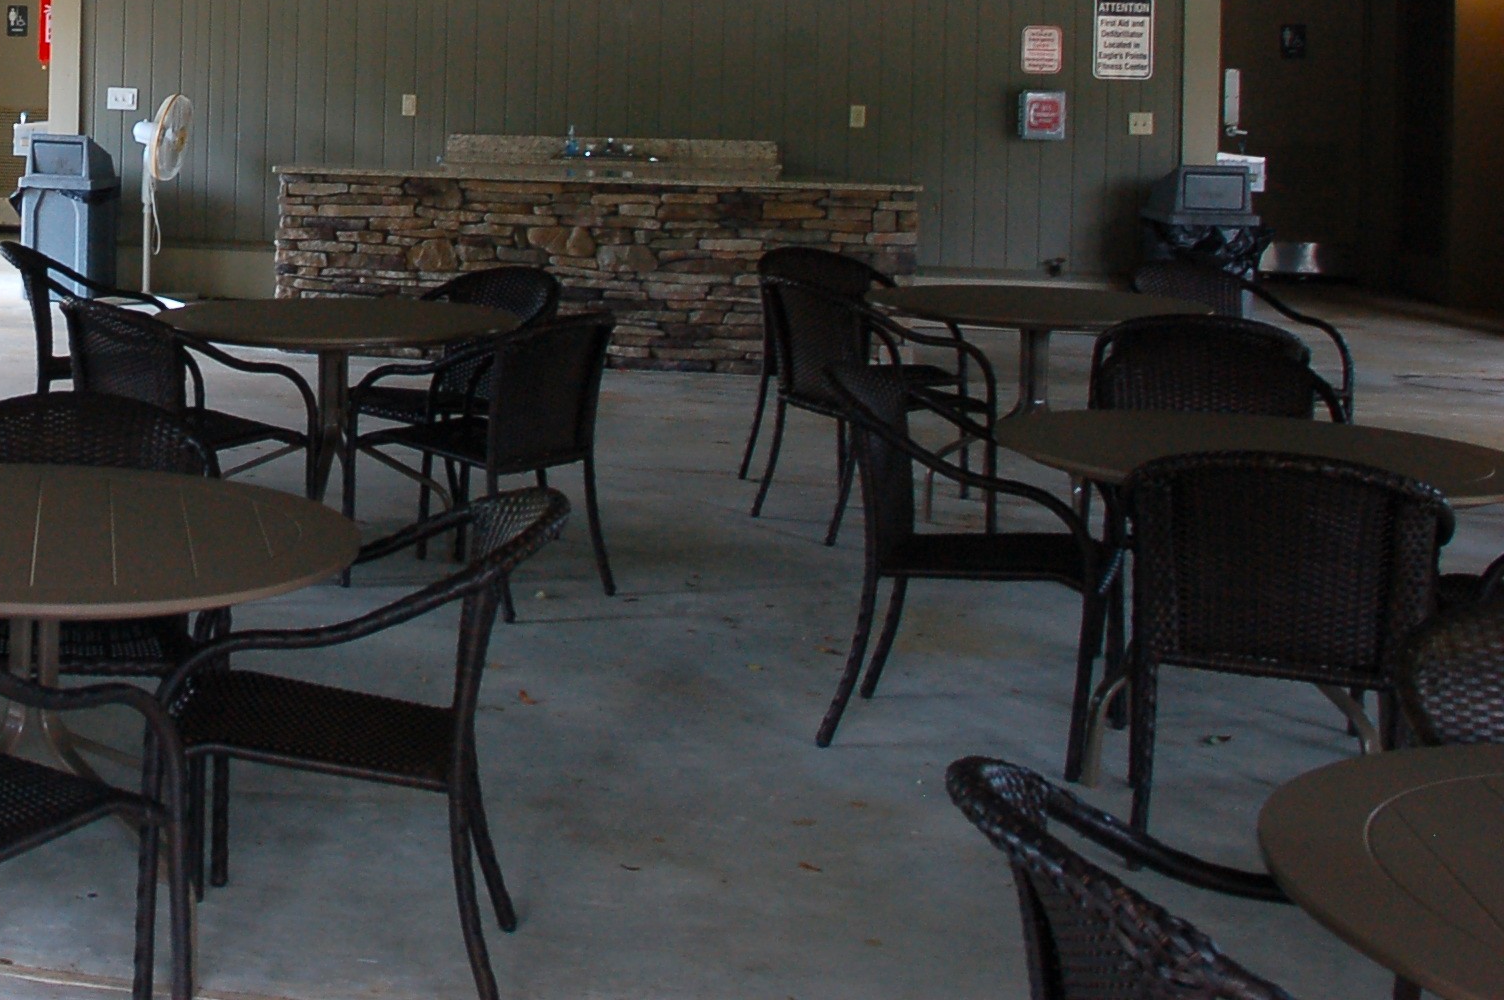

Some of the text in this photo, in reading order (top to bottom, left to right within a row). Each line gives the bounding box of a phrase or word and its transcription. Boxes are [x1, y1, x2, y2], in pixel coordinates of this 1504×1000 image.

[1098, 2, 1150, 13] ATTENTION
[1101, 19, 1144, 27] First Aid and
[1103, 41, 1132, 49] Located
[1124, 62, 1148, 71] Center
